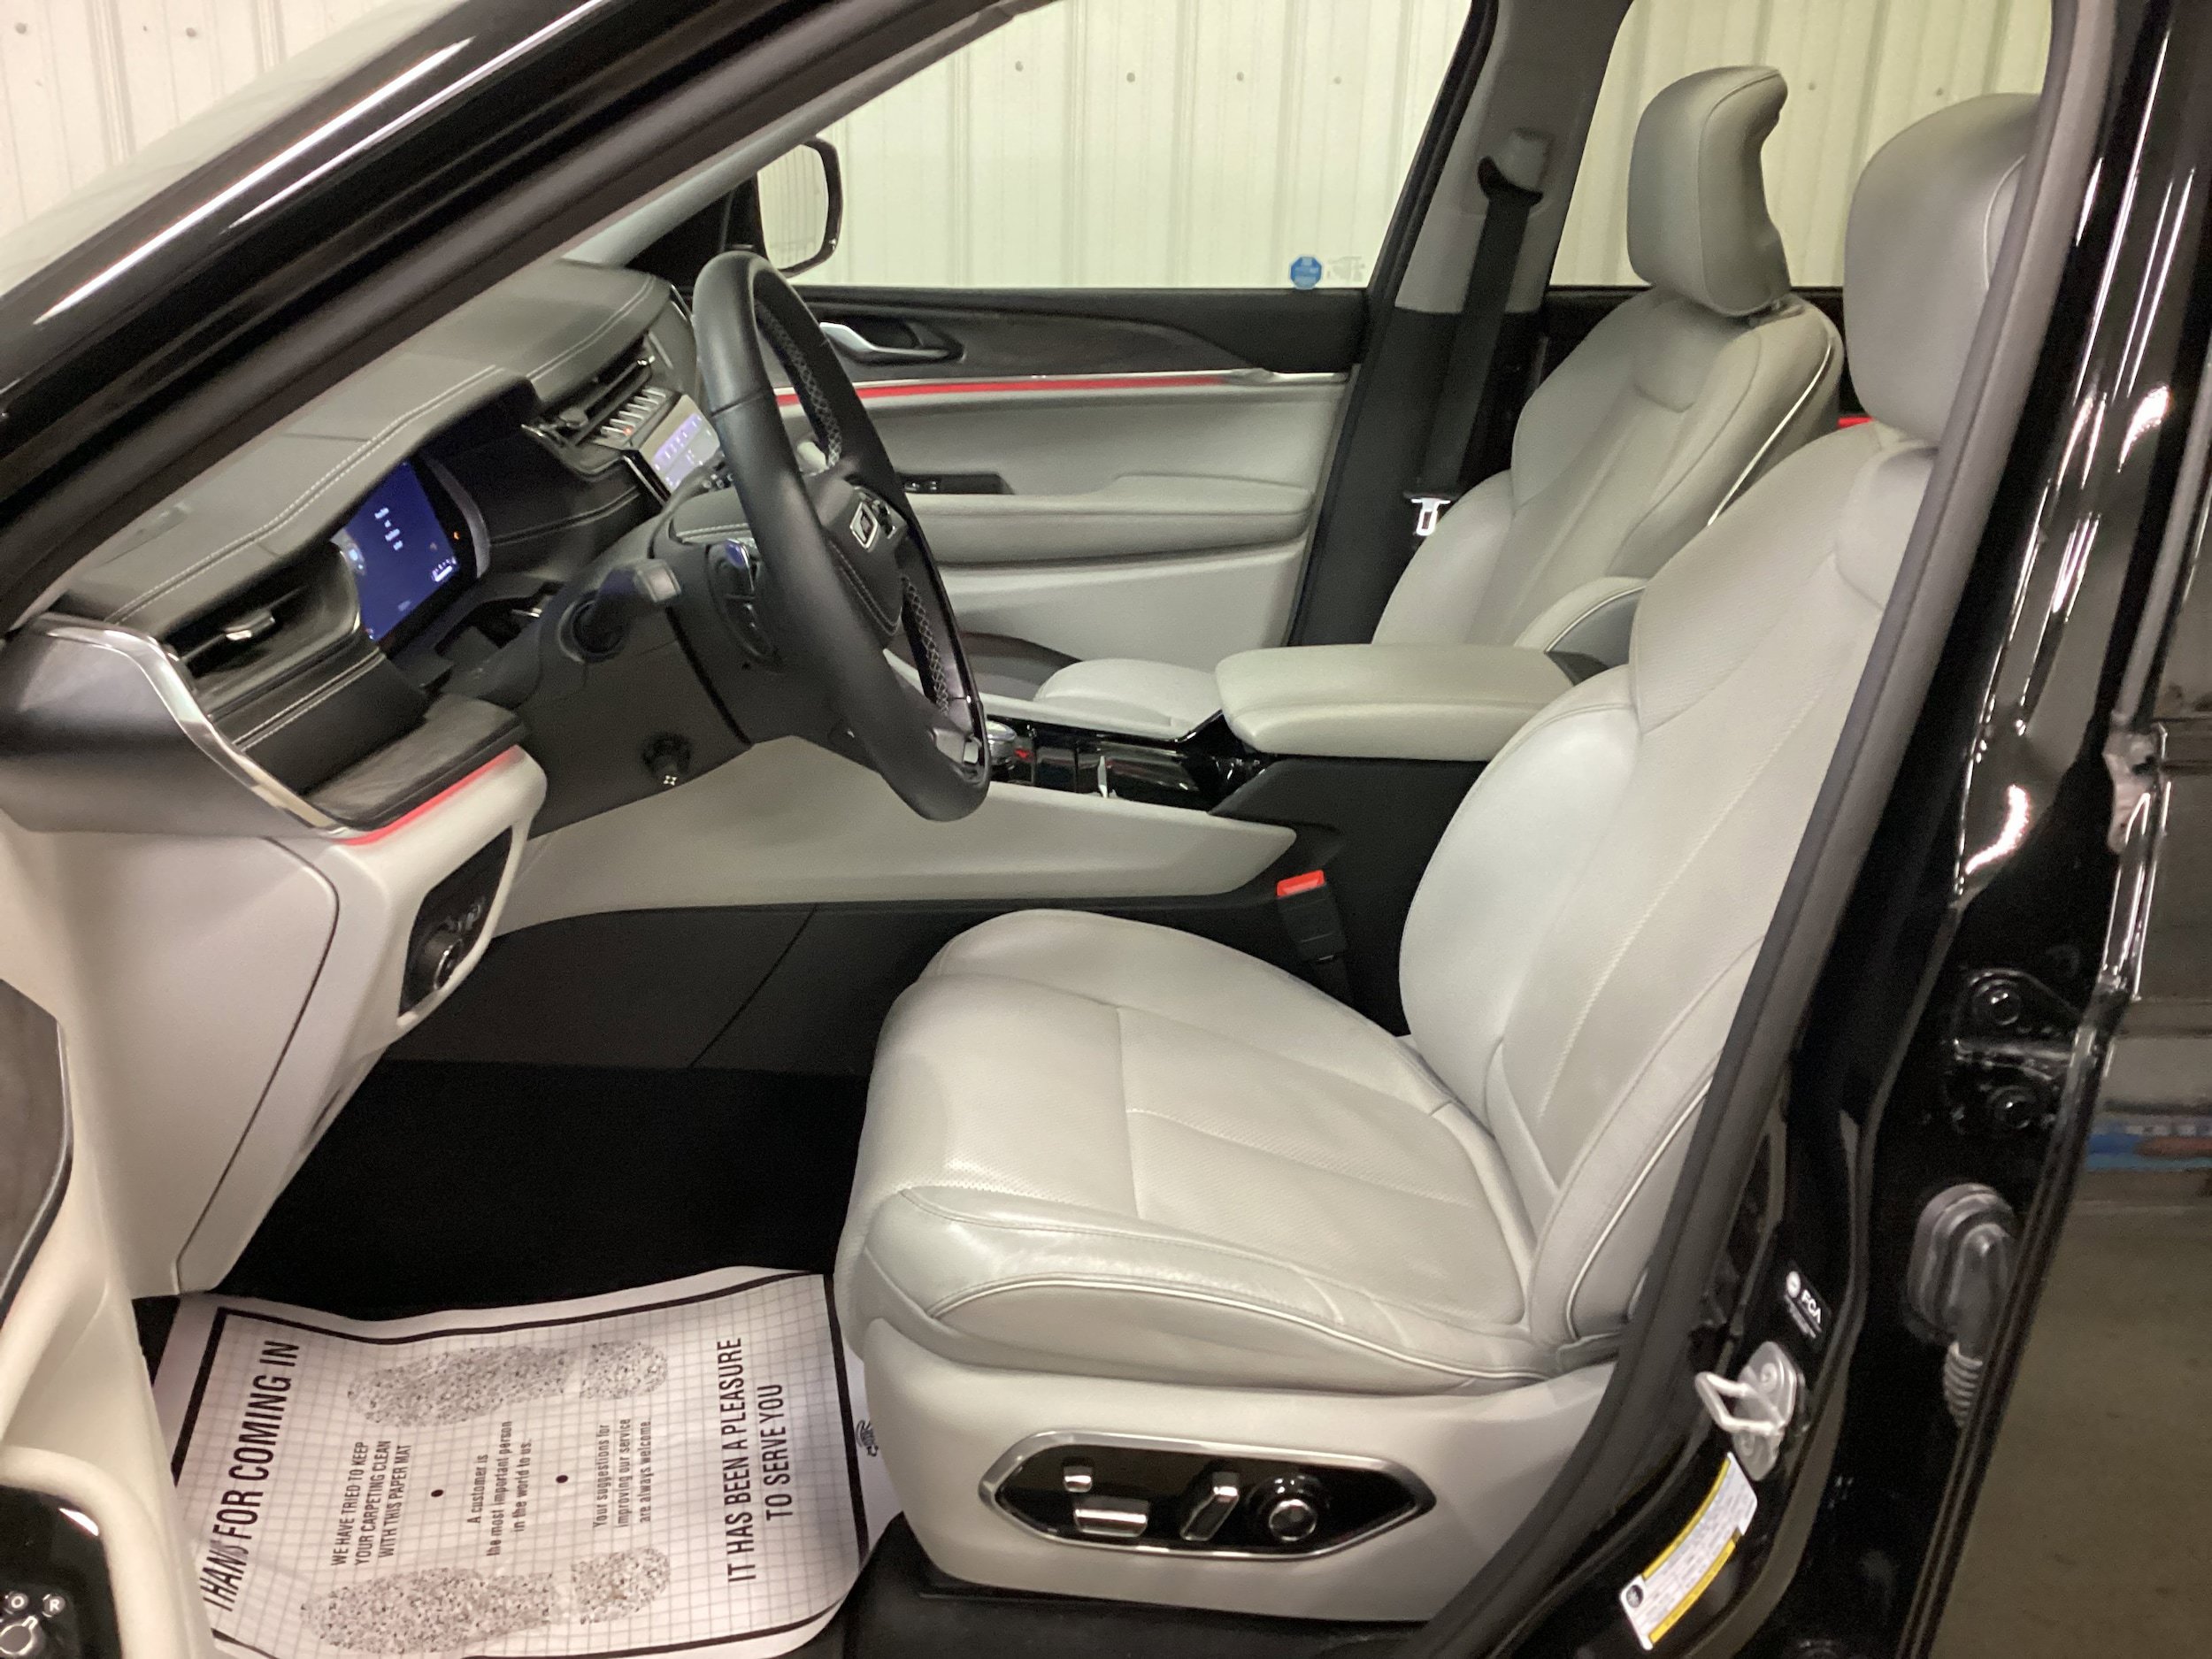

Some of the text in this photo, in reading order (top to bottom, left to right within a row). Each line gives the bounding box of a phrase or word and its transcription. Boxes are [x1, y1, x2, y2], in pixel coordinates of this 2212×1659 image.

[259, 1340, 300, 1367] IN
[228, 1375, 292, 1481] COMING
[474, 1454, 488, 1463] is
[516, 1457, 531, 1468] to
[593, 1425, 612, 1528] Your suggestions for
[615, 1419, 633, 1528] improving our service
[717, 1338, 757, 1583] IT HAS BEEN A PLEASURE
[757, 1384, 794, 1521] TO SERVE YOU
[331, 1441, 369, 1566] WE HAVE TRIED TO KEEP
[354, 1440, 391, 1565] YOUR CARPETING CLEAN
[379, 1445, 411, 1558] WITH THIS PAPER MAT
[471, 1467, 487, 1513] customer
[486, 1421, 513, 1556] the most important person
[515, 1470, 530, 1497] world
[637, 1467, 655, 1502] always
[212, 1489, 264, 1540] FOR
[511, 1501, 527, 1517] the
[511, 1521, 526, 1532] in
[640, 1506, 651, 1523] are
[50, 1599, 60, 1612] R
